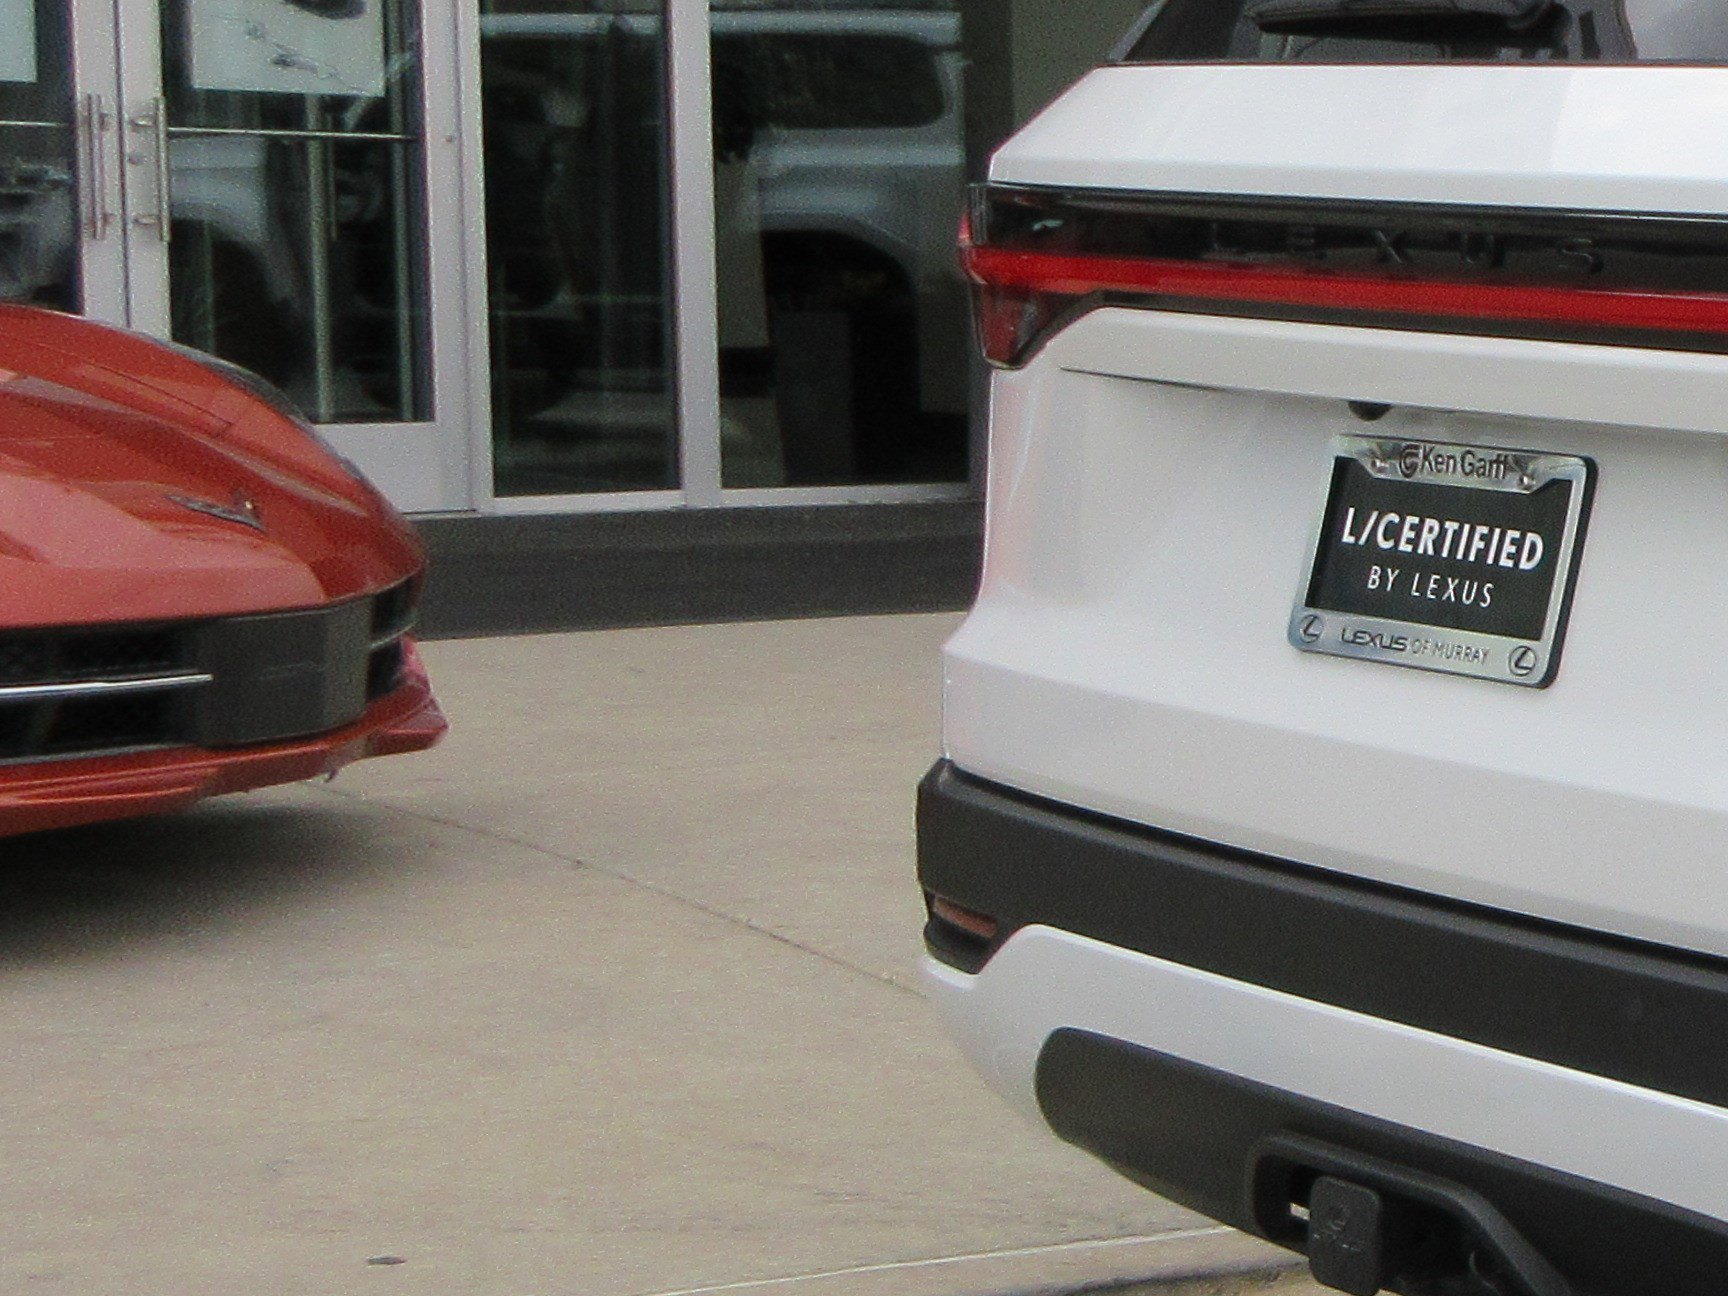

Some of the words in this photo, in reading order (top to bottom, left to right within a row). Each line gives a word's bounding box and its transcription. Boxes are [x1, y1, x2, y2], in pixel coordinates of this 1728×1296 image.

[1206, 220, 1604, 275] LEXUS
[1420, 444, 1458, 474] Ken
[1341, 506, 1544, 570] L/CERTIFIED
[1367, 565, 1399, 592] BY
[1410, 576, 1494, 608] LEXUS
[1341, 626, 1408, 652] LEXUS
[1434, 640, 1490, 665] MURRAY
